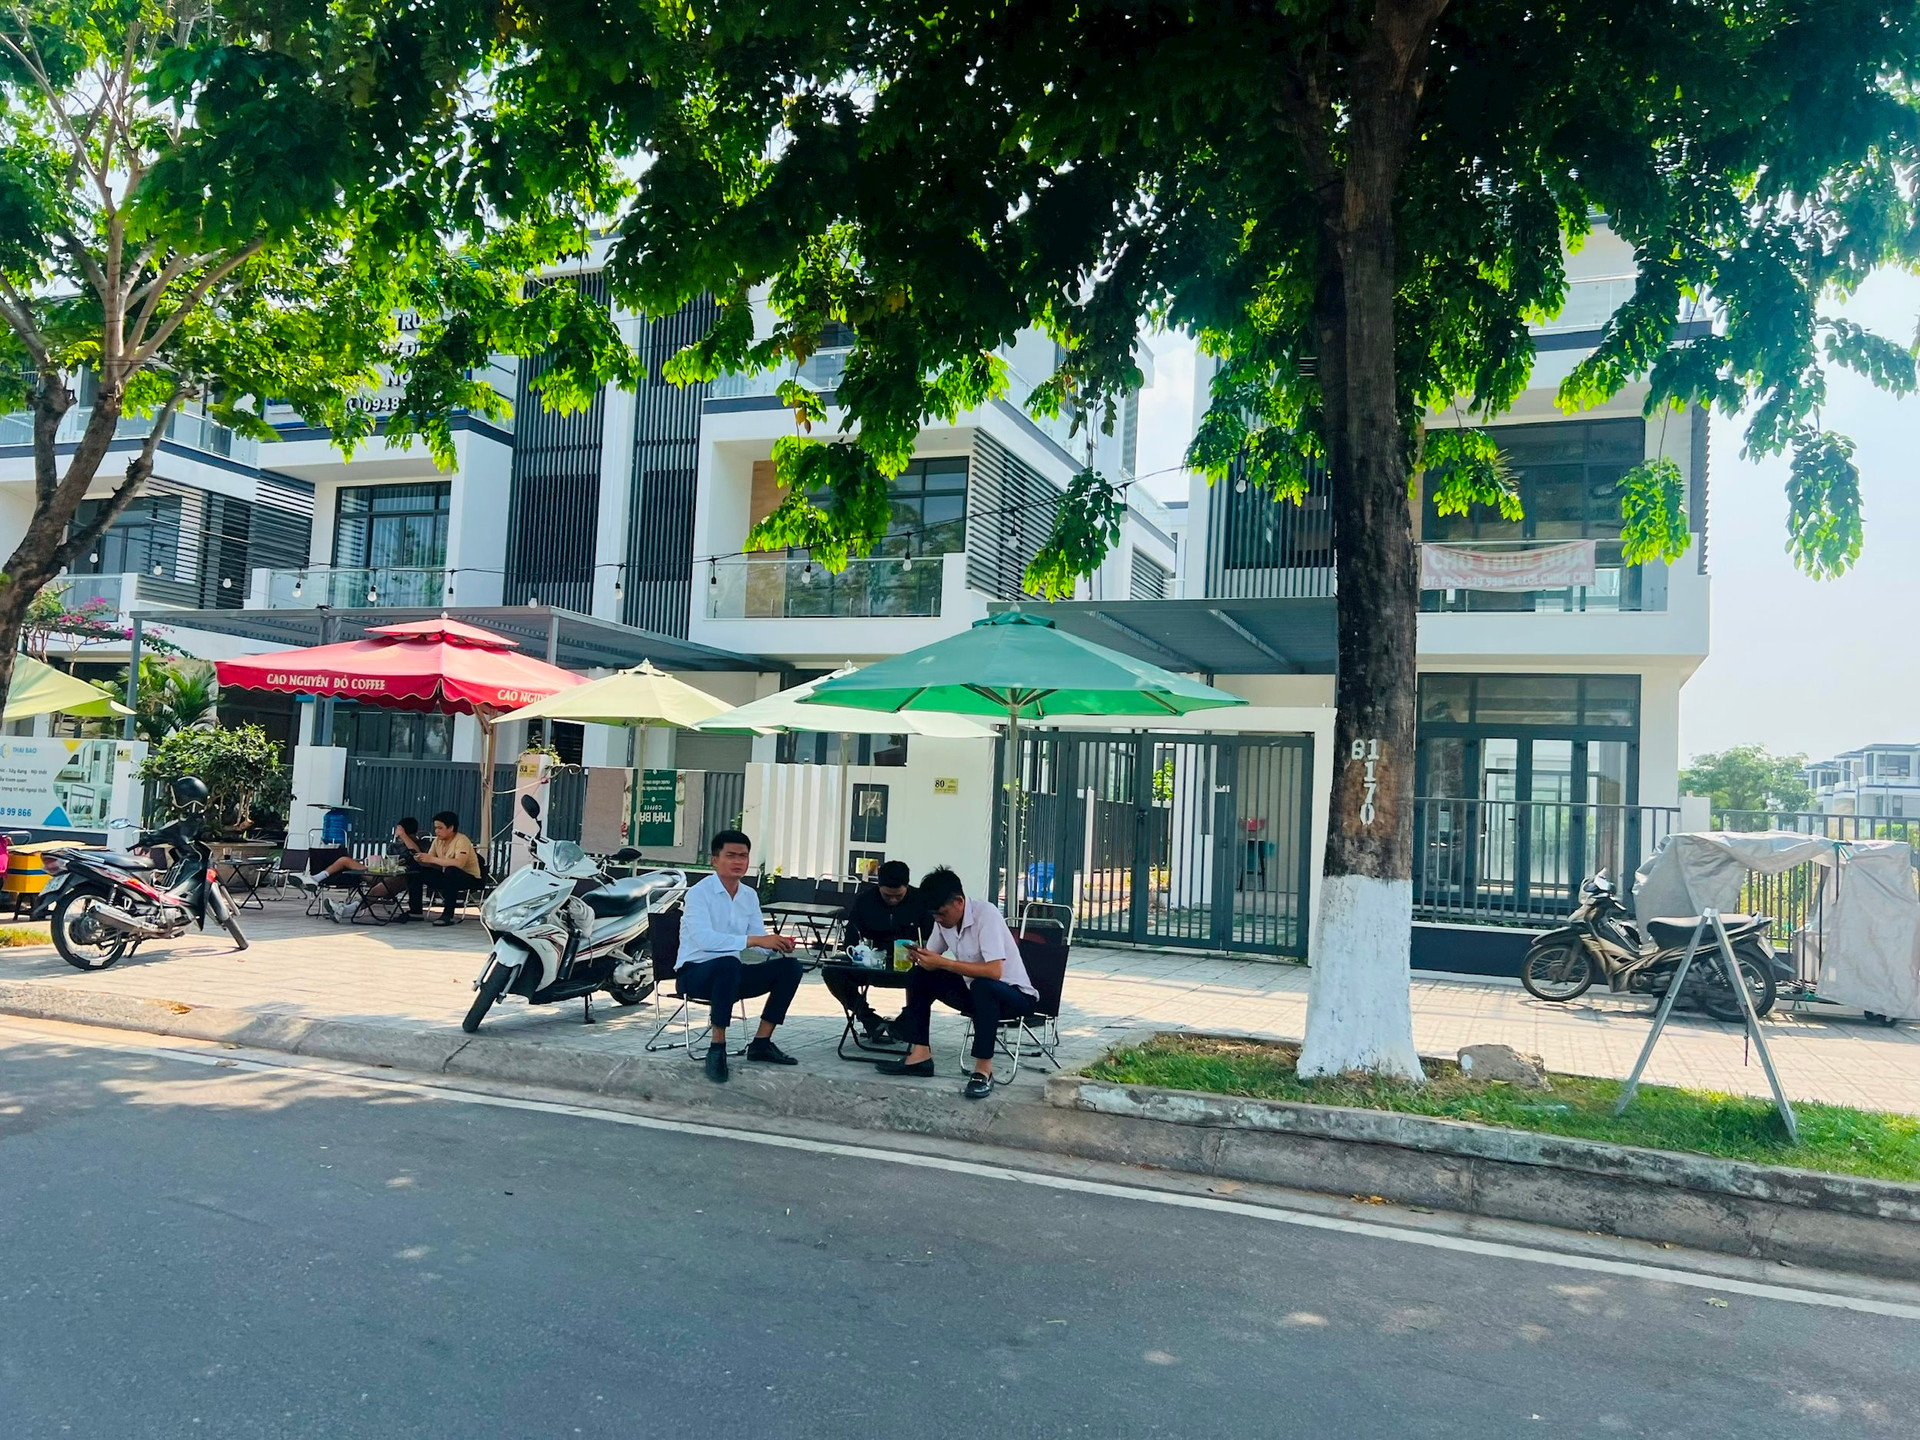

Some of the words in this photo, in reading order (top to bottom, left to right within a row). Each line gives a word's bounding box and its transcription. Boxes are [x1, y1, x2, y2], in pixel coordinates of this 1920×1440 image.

[266, 673, 287, 685] CAO
[351, 678, 386, 690] COFFEE
[497, 688, 518, 701] CAO
[935, 779, 945, 789] 80
[7, 808, 16, 816] 99
[18, 809, 32, 817] 866
